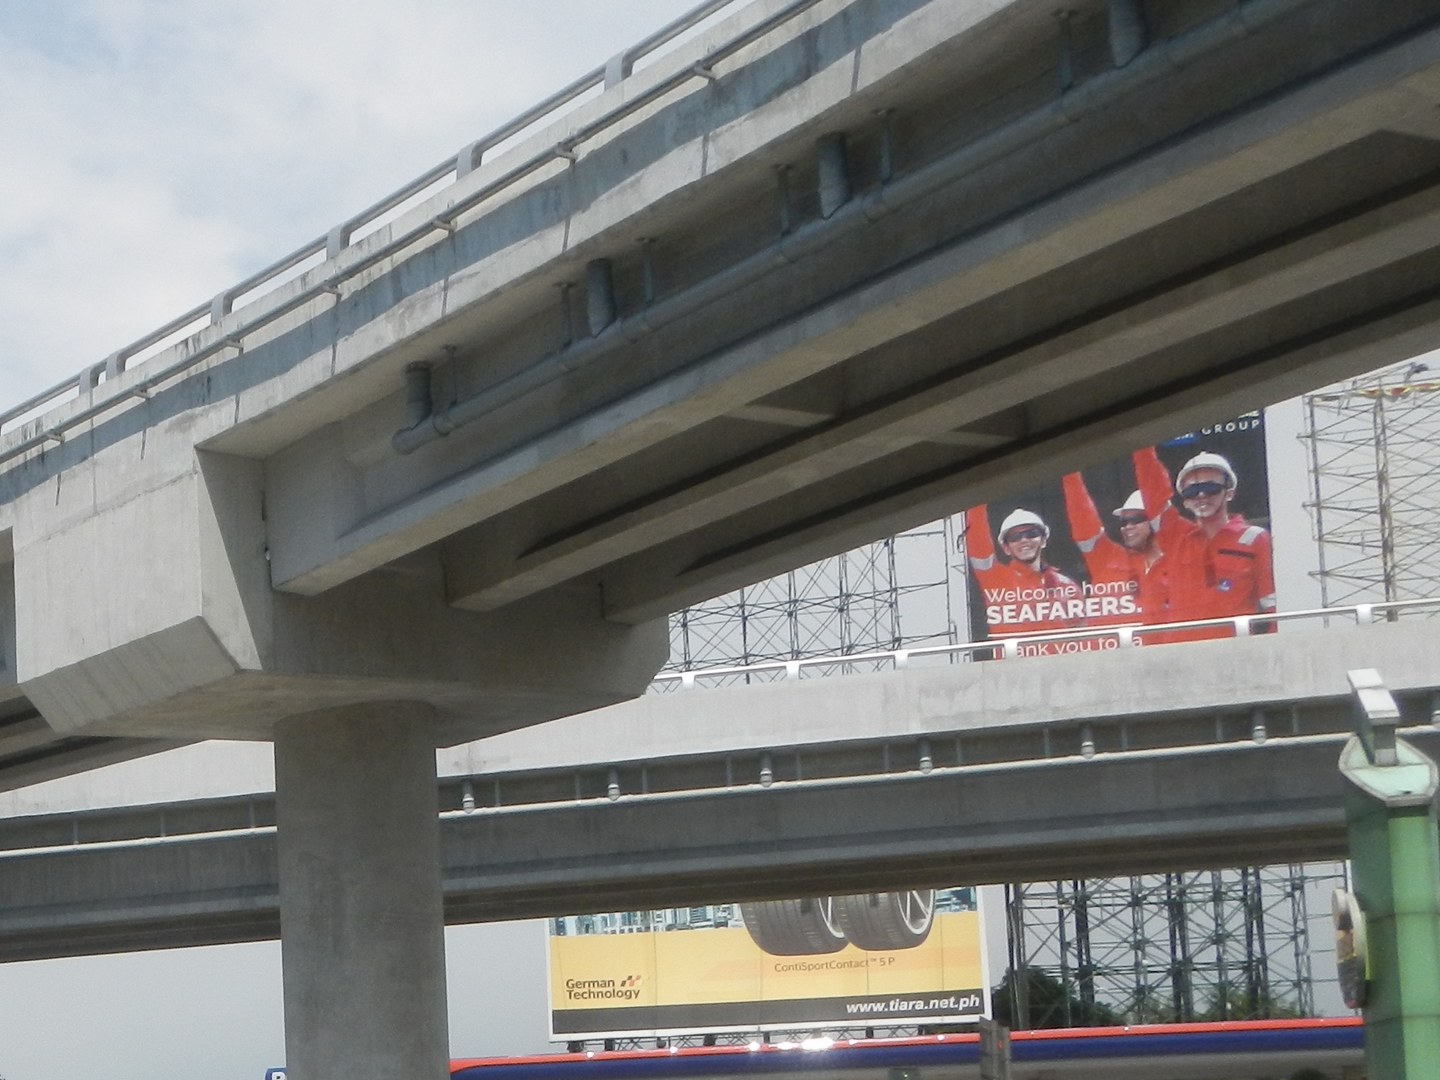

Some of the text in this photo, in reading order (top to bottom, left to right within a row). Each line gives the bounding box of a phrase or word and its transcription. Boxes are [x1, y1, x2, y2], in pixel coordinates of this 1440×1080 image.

[1201, 419, 1260, 435] GROUP
[984, 580, 1138, 603] Welcome home
[986, 595, 1142, 625] SEAFARERS.
[1054, 639, 1091, 656] you
[1098, 636, 1118, 651] to
[879, 957, 886, 967] 5
[888, 956, 895, 966] P
[566, 978, 616, 990] German
[566, 987, 641, 1000] Technology
[846, 993, 980, 1015] www.tiara.net.ph
